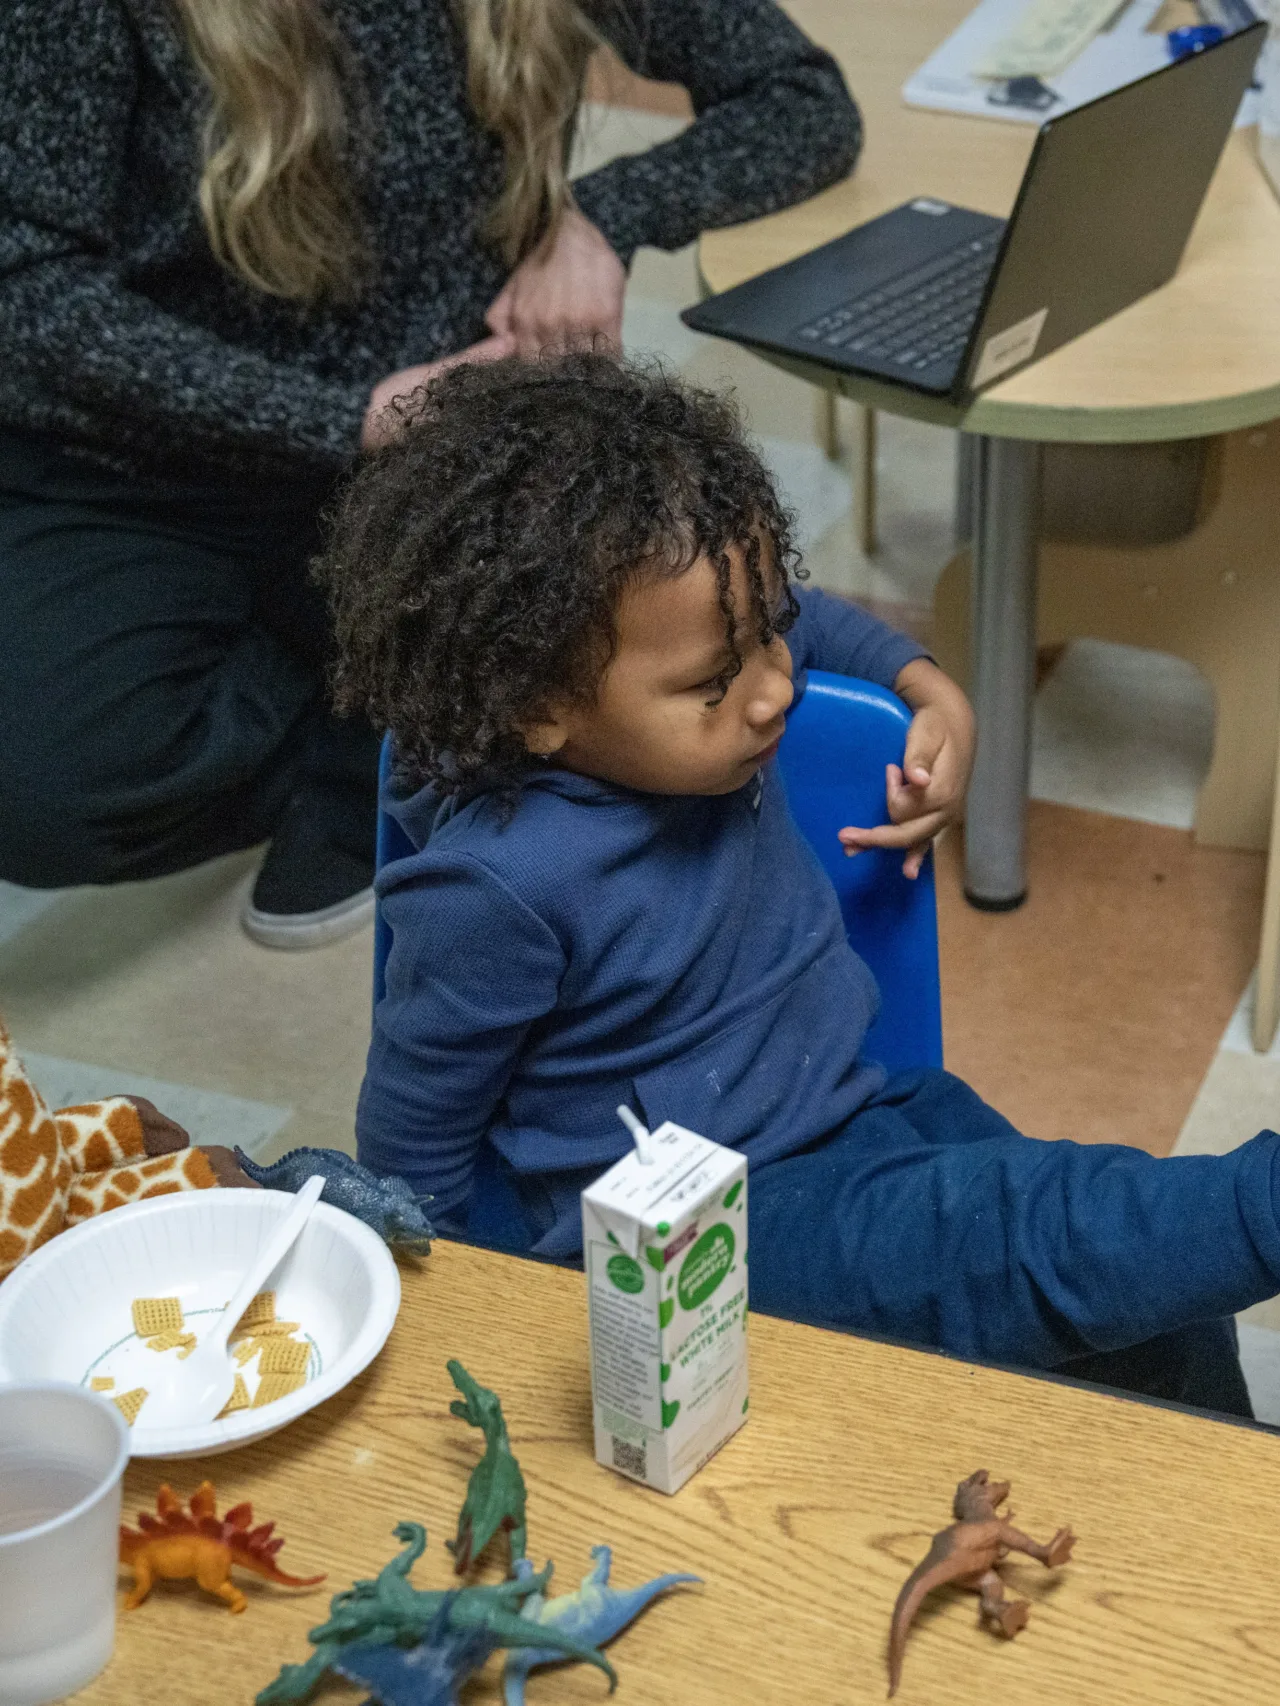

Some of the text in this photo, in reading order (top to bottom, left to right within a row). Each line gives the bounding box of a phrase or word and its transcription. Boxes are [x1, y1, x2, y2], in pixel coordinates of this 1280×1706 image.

[670, 1288, 745, 1361] LACTOSE FREE
[680, 1332, 713, 1369] WHITE
[716, 1311, 740, 1337] MILK
